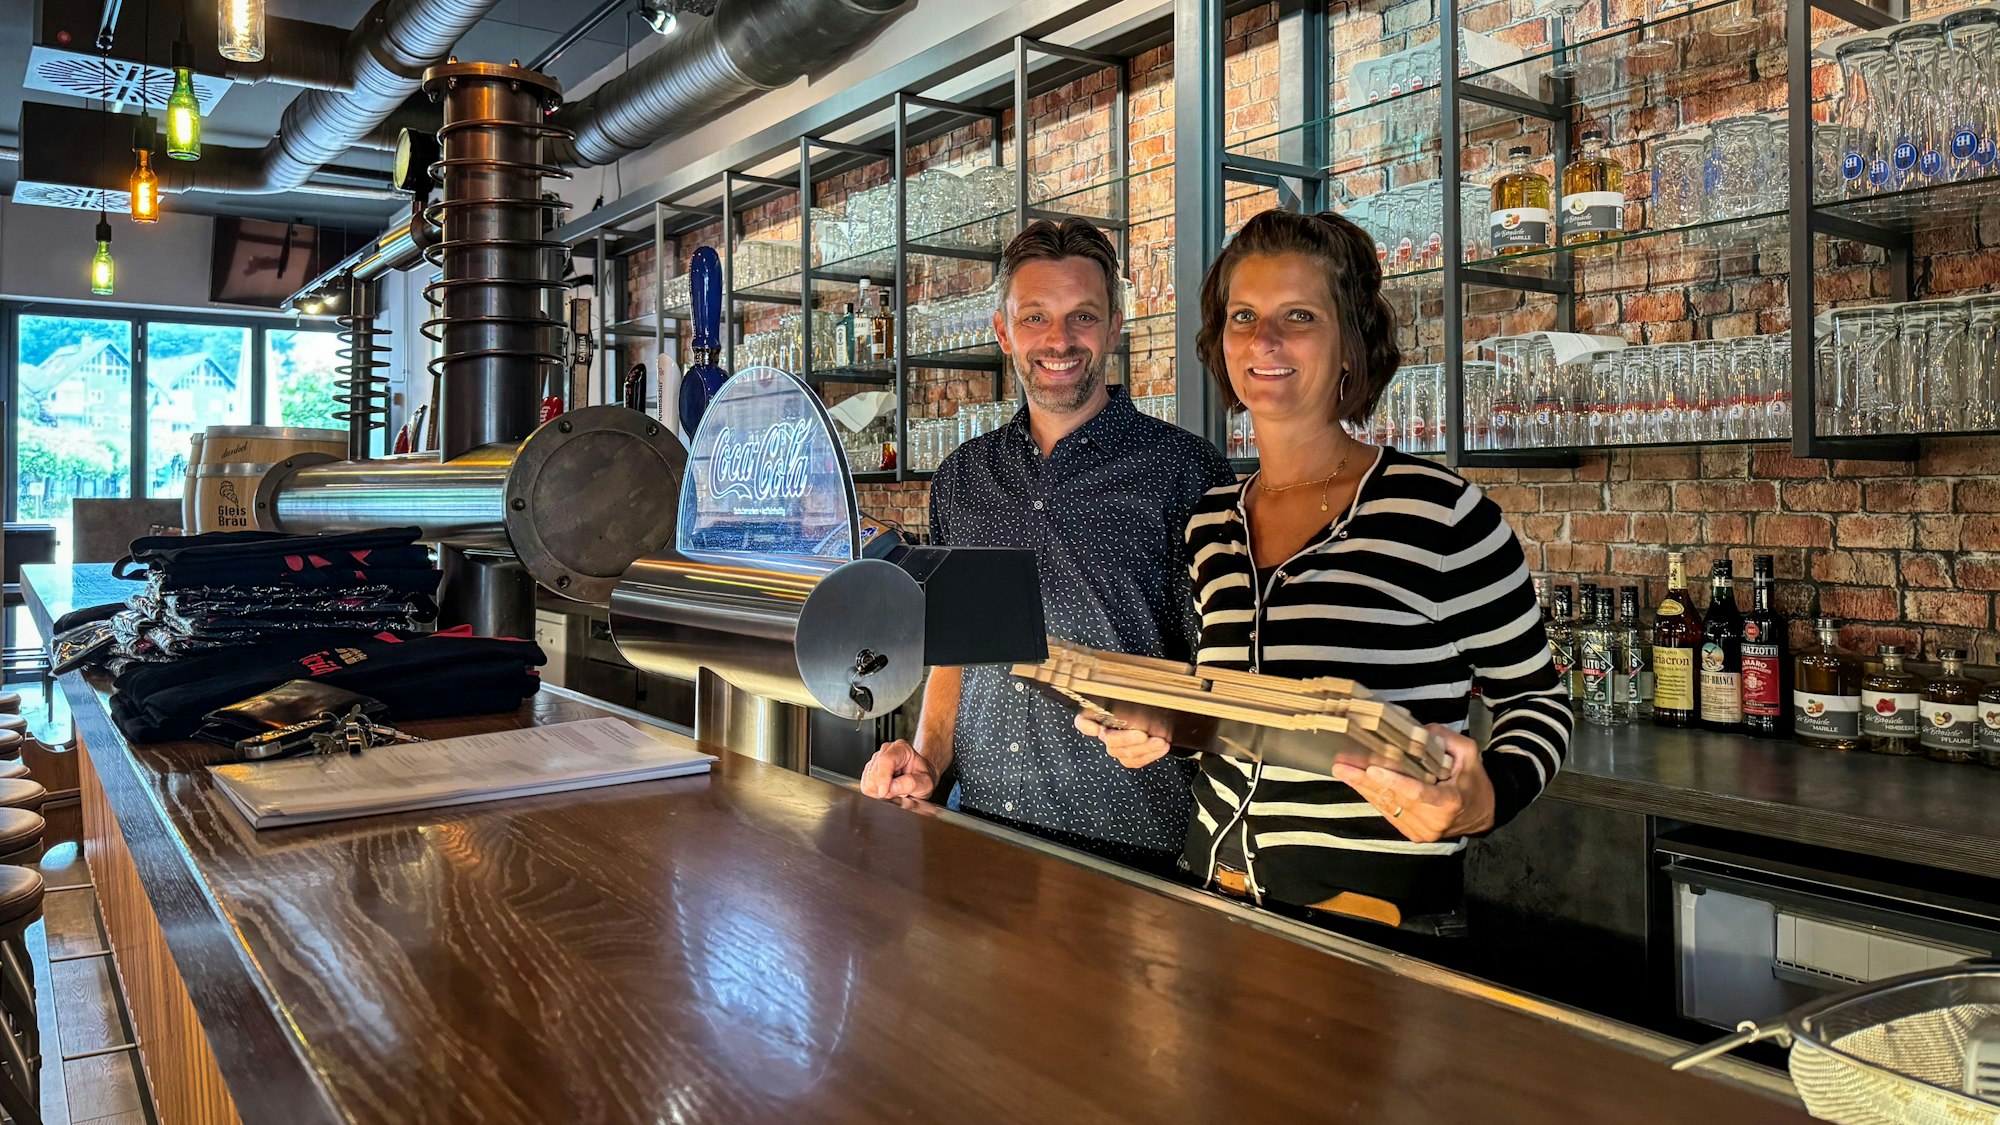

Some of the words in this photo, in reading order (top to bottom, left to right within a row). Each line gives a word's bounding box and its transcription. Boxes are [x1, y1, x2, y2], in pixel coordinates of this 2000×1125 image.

[578, 335, 587, 362] CAMBA
[221, 441, 248, 459] dunkel
[709, 417, 812, 500] Coca-Cola
[218, 505, 247, 516] Gleis
[218, 515, 247, 527] Bräu
[1552, 655, 1568, 665] TOS
[1812, 725, 1839, 733] MARILLE
[1941, 736, 1972, 744] PFLAUME
